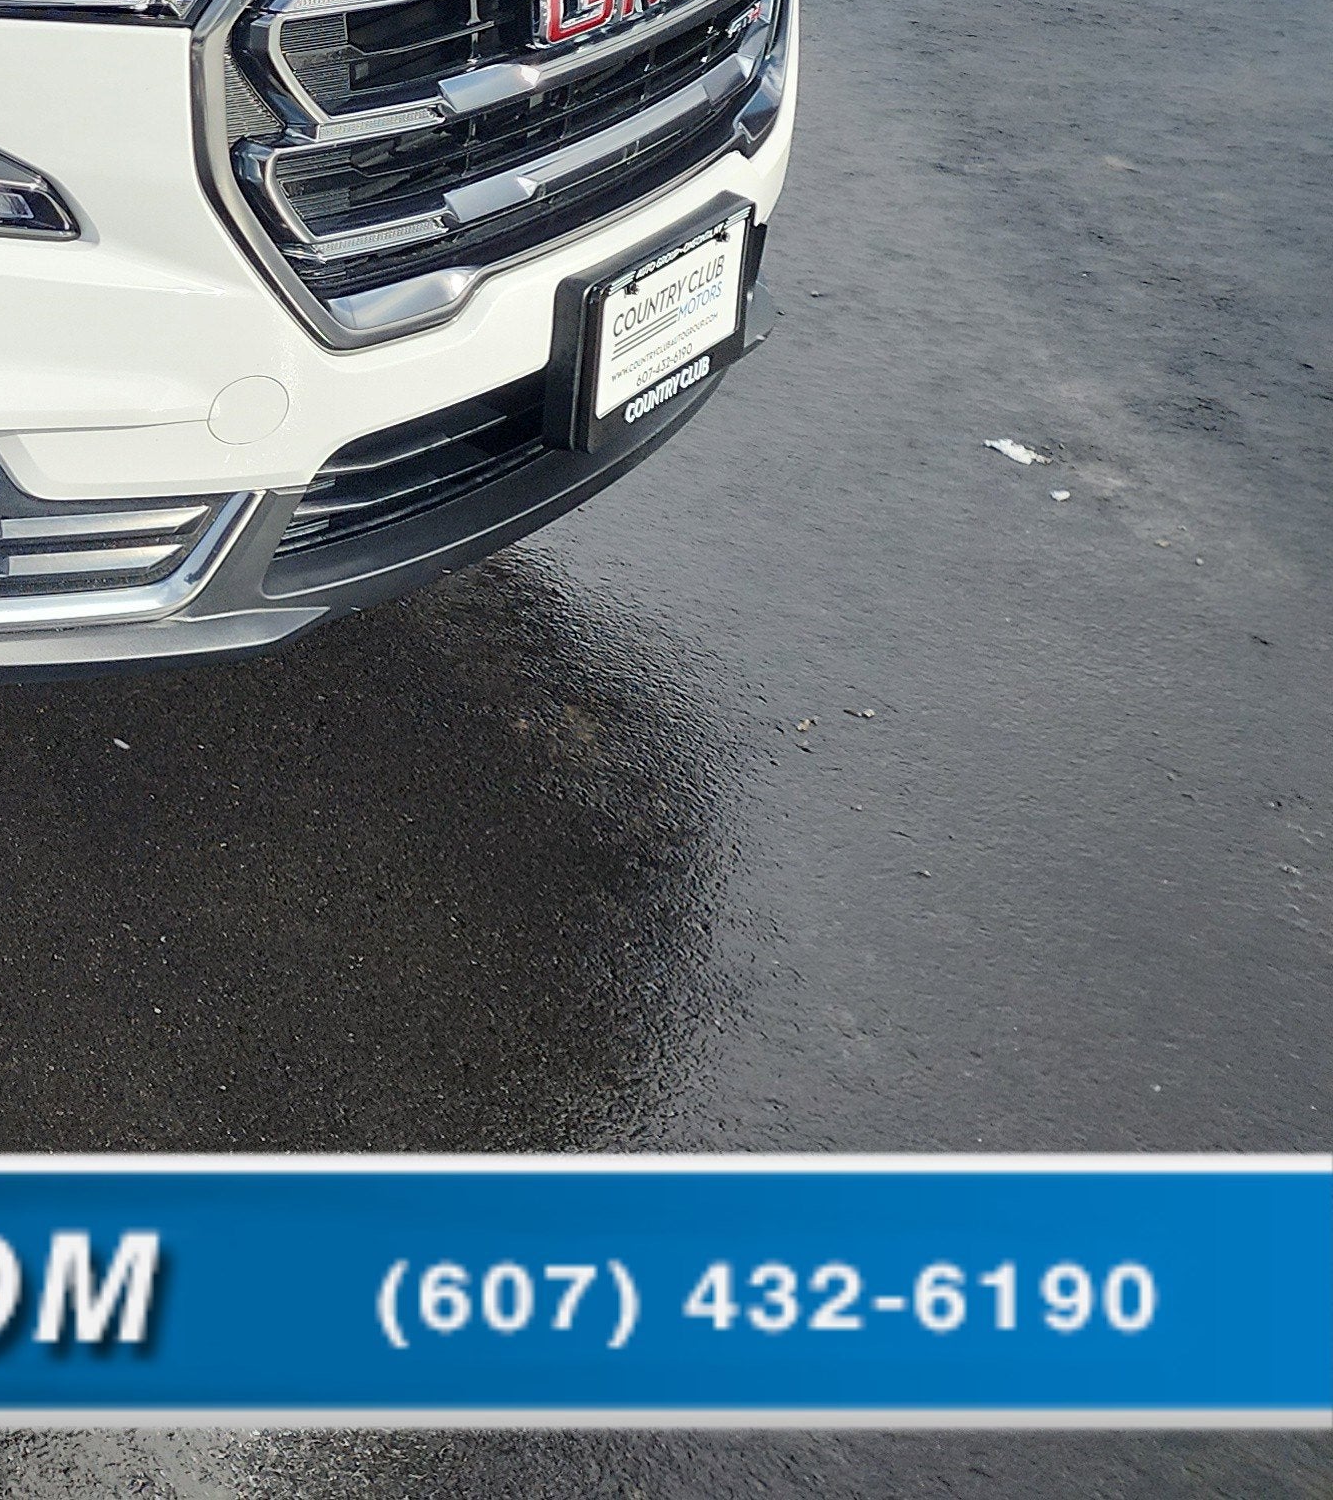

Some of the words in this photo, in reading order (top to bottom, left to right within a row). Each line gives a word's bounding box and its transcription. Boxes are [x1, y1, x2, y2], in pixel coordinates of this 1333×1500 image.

[613, 276, 688, 338] COUNTRY
[688, 254, 725, 294] CLUB
[677, 281, 723, 321] MOTORS
[624, 372, 680, 423] COUNTRY
[679, 355, 711, 389] CLUB
